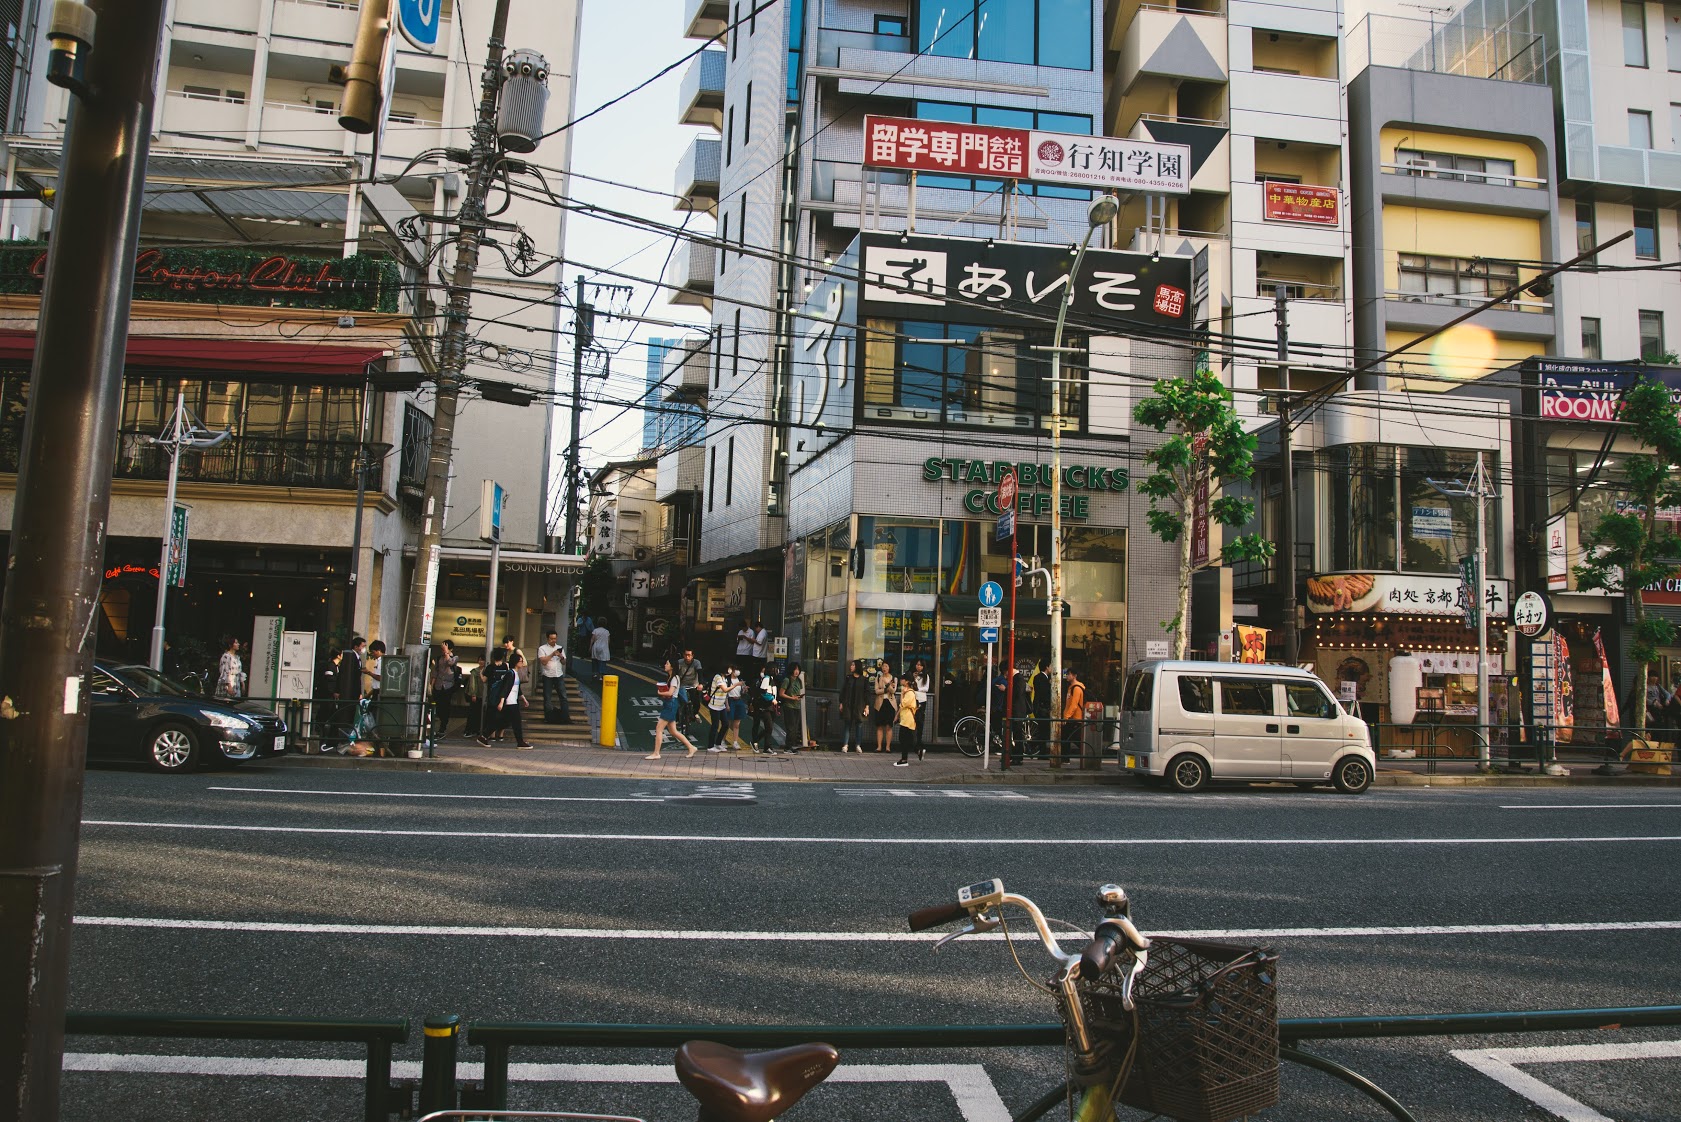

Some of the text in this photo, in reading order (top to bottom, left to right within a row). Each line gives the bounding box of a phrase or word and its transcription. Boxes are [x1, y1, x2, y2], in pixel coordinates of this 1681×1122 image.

[872, 123, 989, 169] 留学専門
[989, 136, 1022, 154] 会社
[992, 155, 1021, 172] 5F
[1068, 142, 1182, 180] 行知学園
[1269, 194, 1336, 208] 中華物産店
[1543, 395, 1621, 420] ROOMS
[924, 457, 1130, 491] STARBUCKS
[505, 563, 584, 575] SOUNDS BLDG
[1423, 588, 1453, 609] 京都
[1516, 608, 1543, 625] 牛カツ
